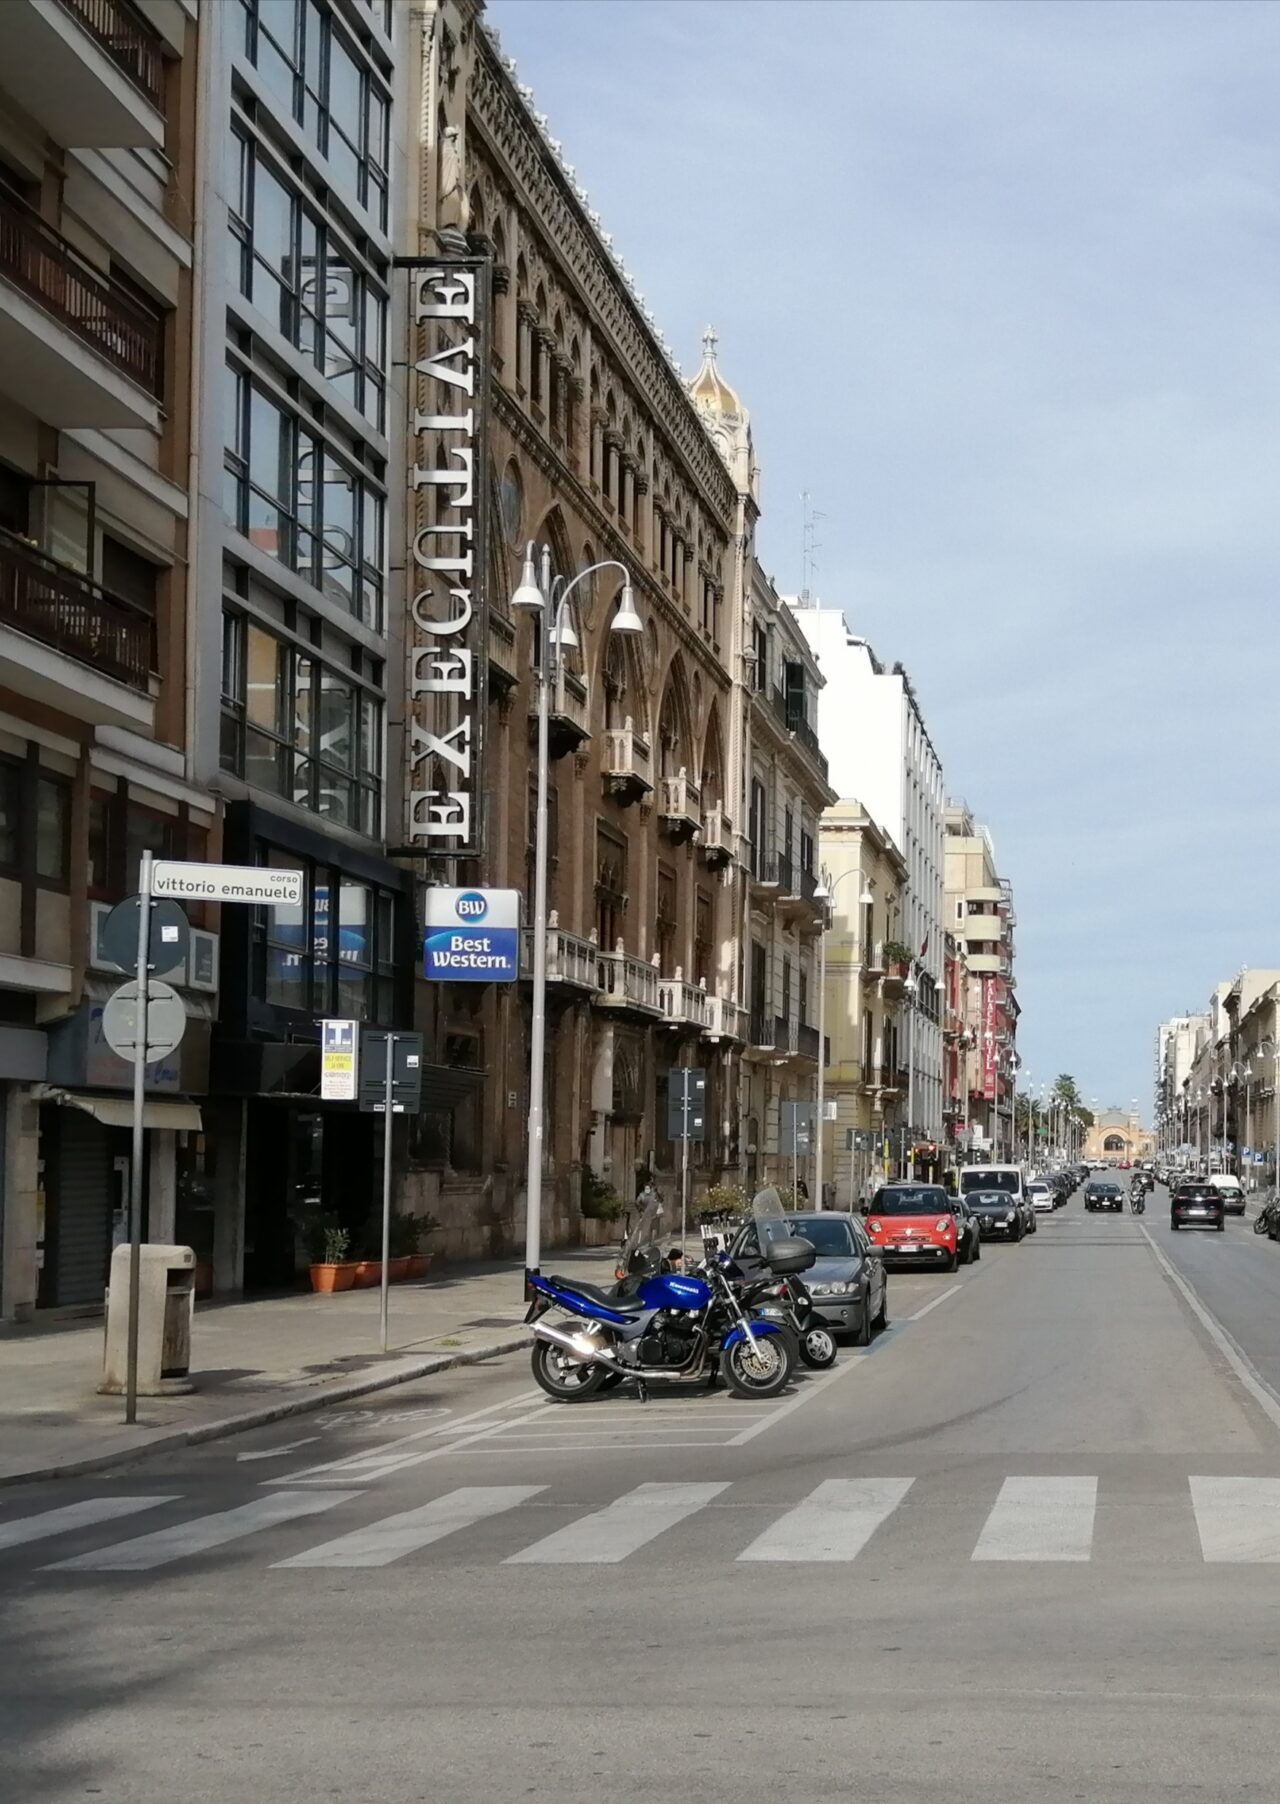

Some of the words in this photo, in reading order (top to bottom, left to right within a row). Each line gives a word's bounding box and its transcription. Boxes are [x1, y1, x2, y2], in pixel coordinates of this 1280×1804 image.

[409, 271, 475, 844] EXECUTIVE
[157, 877, 216, 894] vittorio
[221, 884, 298, 899] emanuele
[270, 874, 299, 884] corso
[458, 900, 485, 915] BW
[450, 935, 491, 952] Best
[986, 979, 995, 1026] PALACE
[985, 1028, 995, 1071] OTEL
